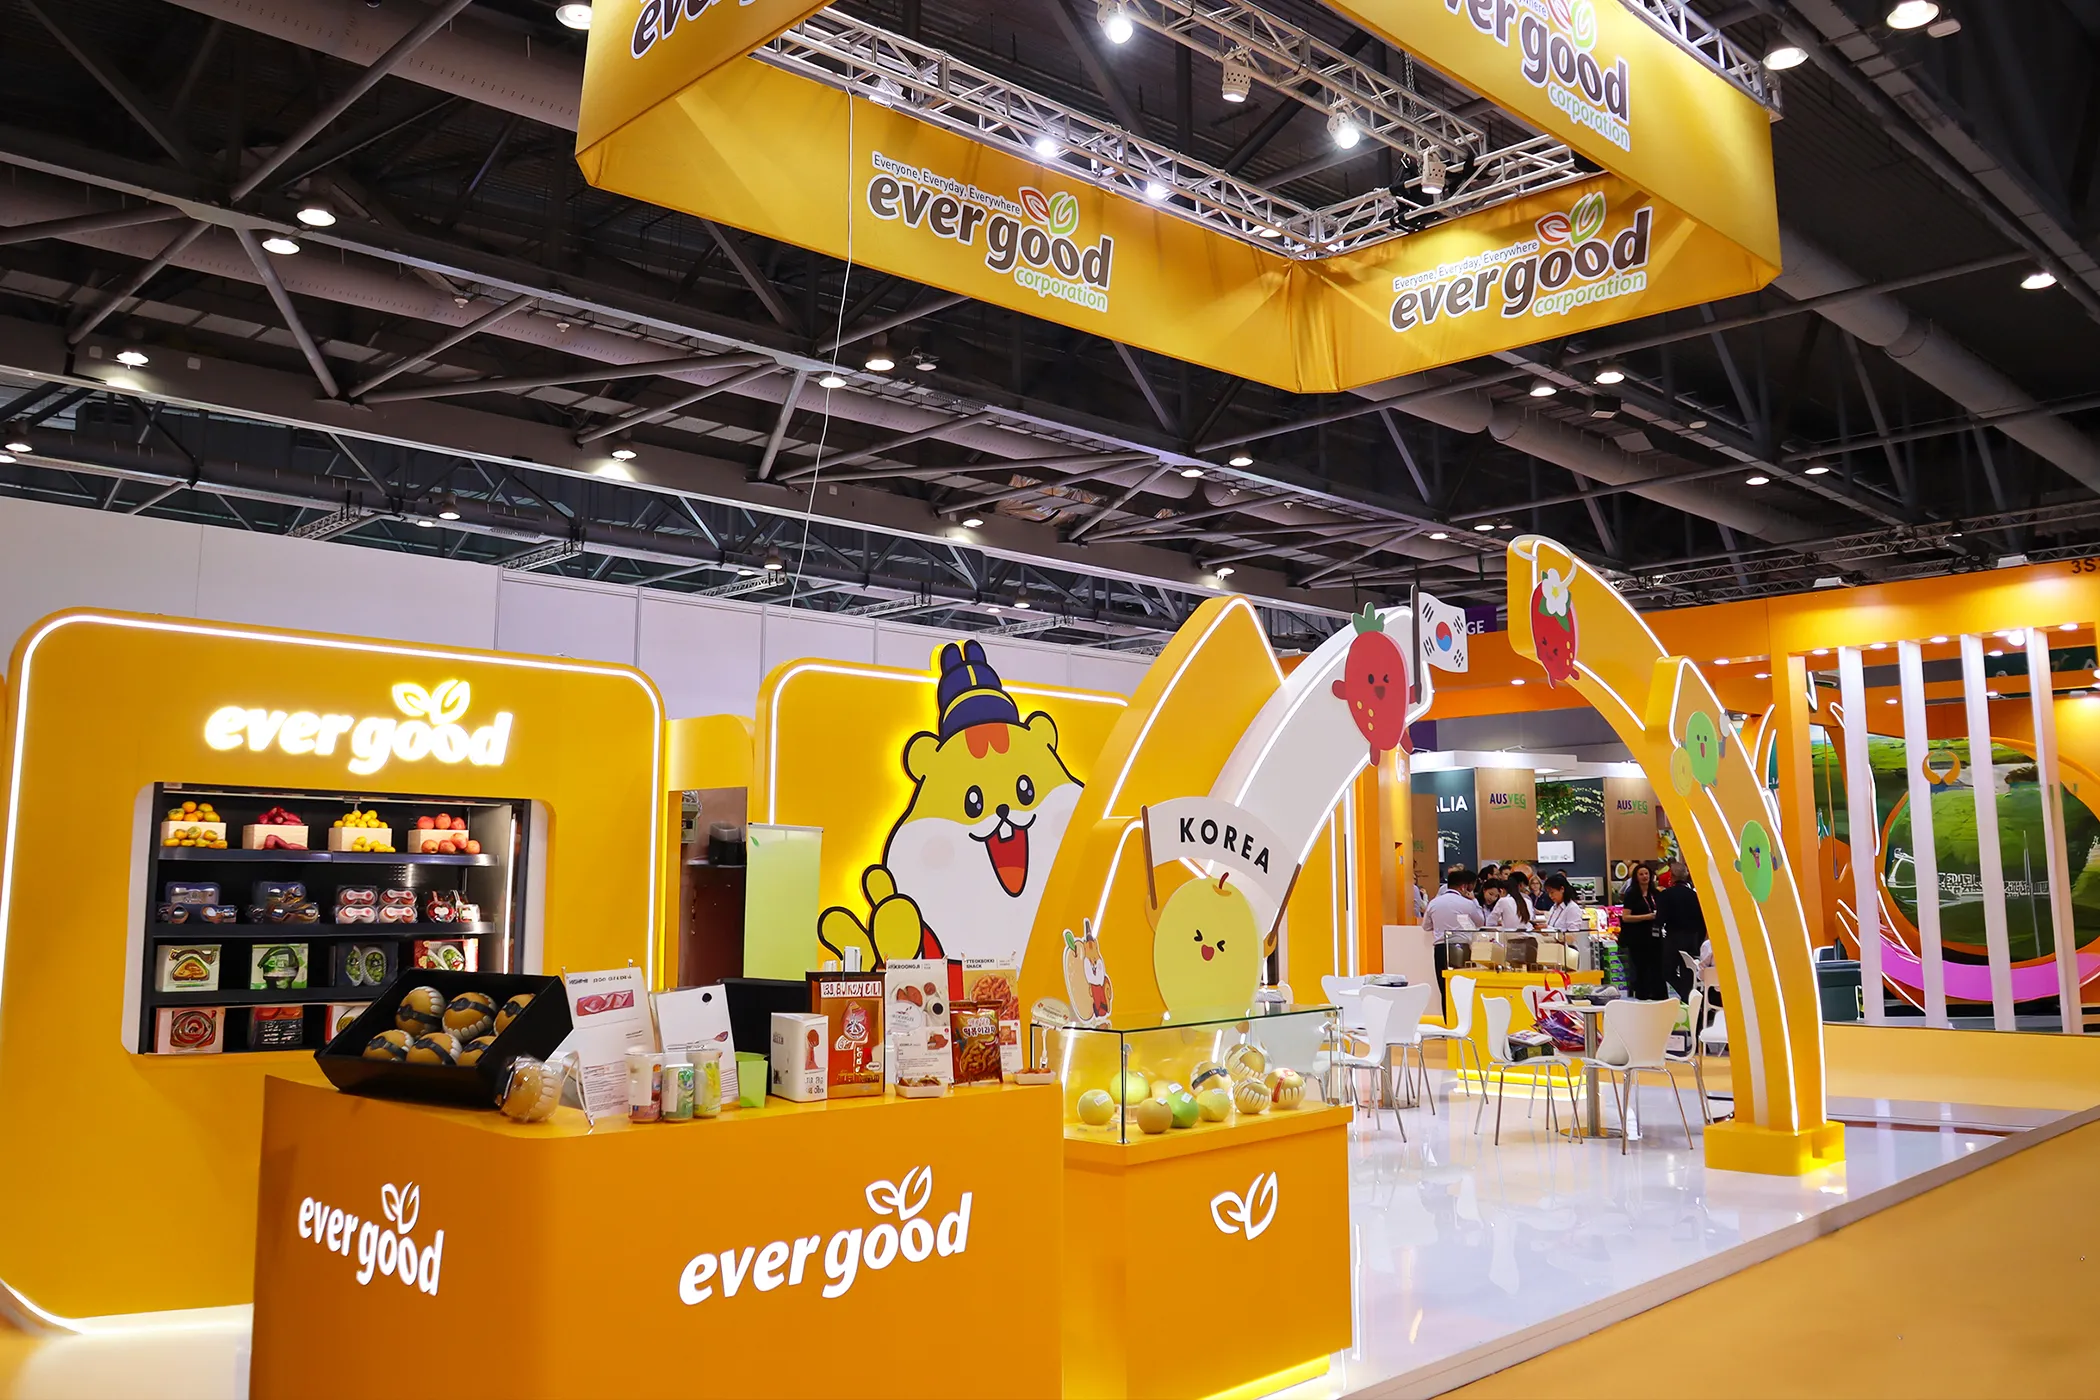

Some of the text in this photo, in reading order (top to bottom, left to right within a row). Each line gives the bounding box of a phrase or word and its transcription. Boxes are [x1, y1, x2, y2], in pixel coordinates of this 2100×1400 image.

[1550, 84, 1629, 149] corporation
[874, 154, 1021, 214] Everyone, Everyday, Everywhere
[1395, 272, 1436, 290] Everyone,
[1483, 241, 1538, 264] Everywhere
[1016, 269, 1106, 309] corporation
[1534, 273, 1644, 315] corporation
[1436, 795, 1468, 812] LIA
[1490, 793, 1526, 808] AUSVEG
[1617, 800, 1648, 812] AUSVEG
[1180, 817, 1270, 874] KOREA
